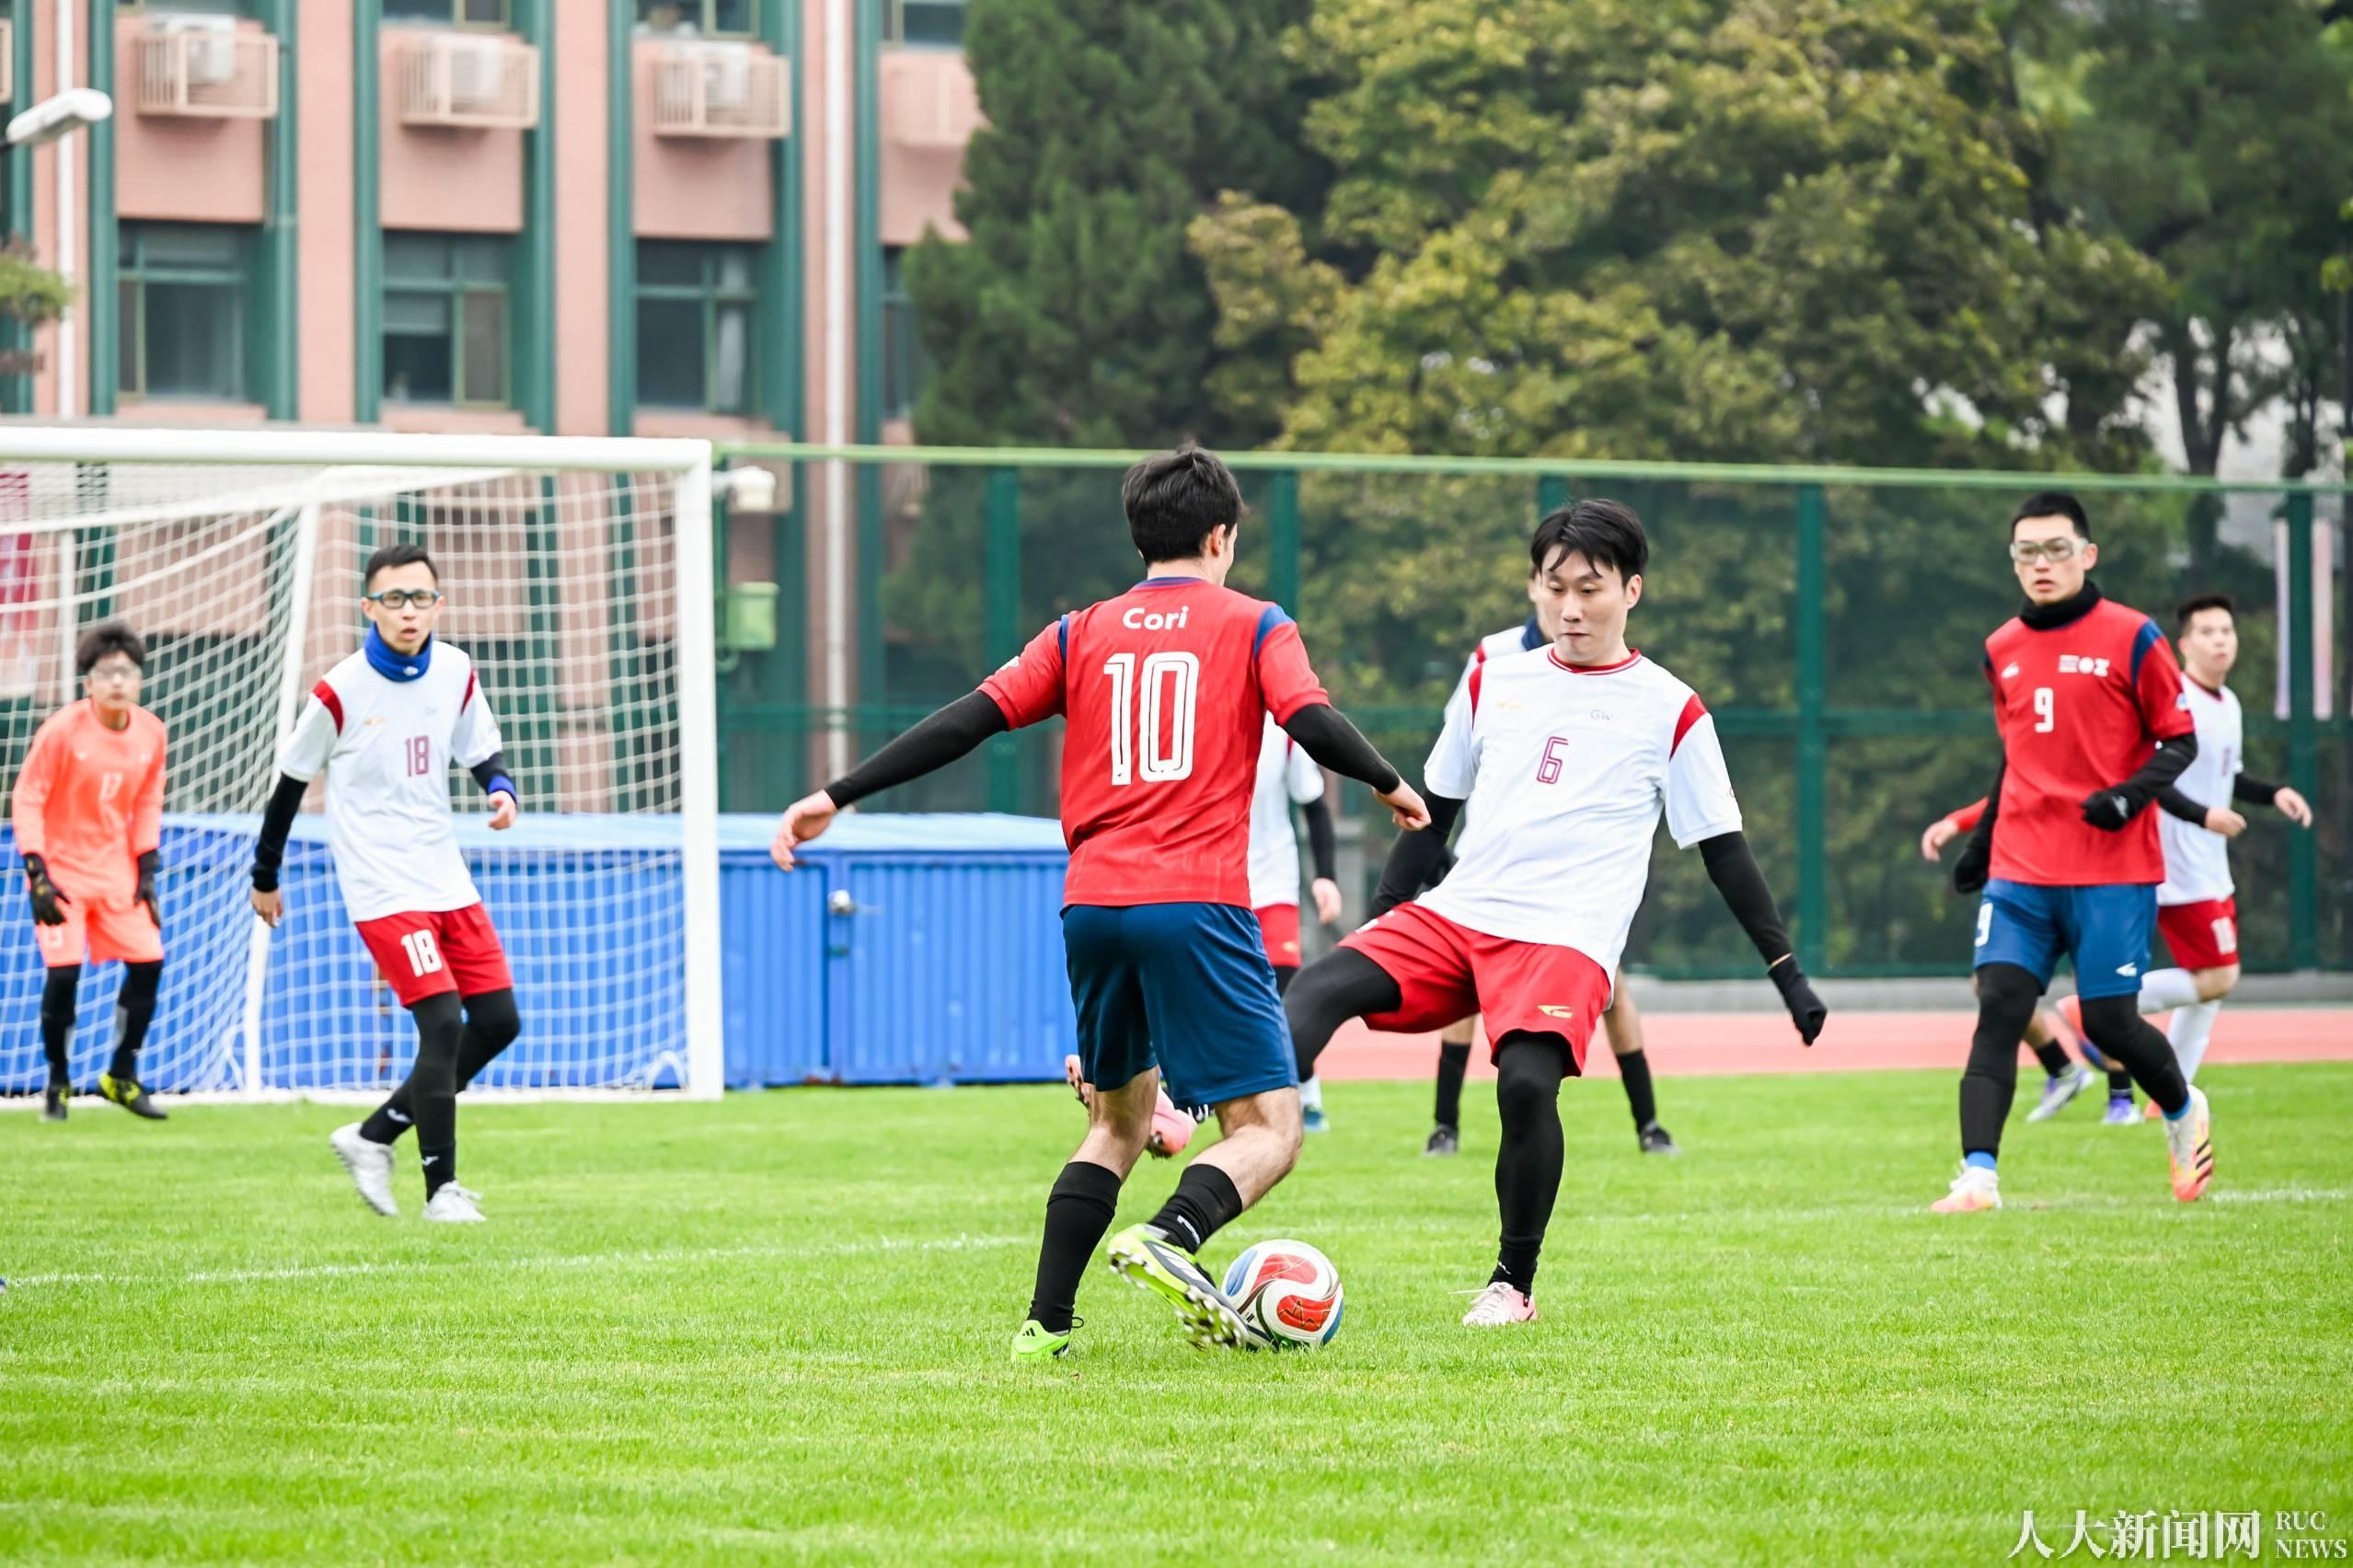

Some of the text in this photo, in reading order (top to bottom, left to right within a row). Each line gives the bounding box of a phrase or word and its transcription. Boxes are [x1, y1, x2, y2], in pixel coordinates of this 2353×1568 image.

[1123, 605, 1190, 630] Cori
[1104, 651, 1200, 786] 10
[2035, 687, 2054, 732] 9
[405, 735, 429, 777] 18
[1537, 736, 1568, 784] 6
[400, 929, 442, 977] 18
